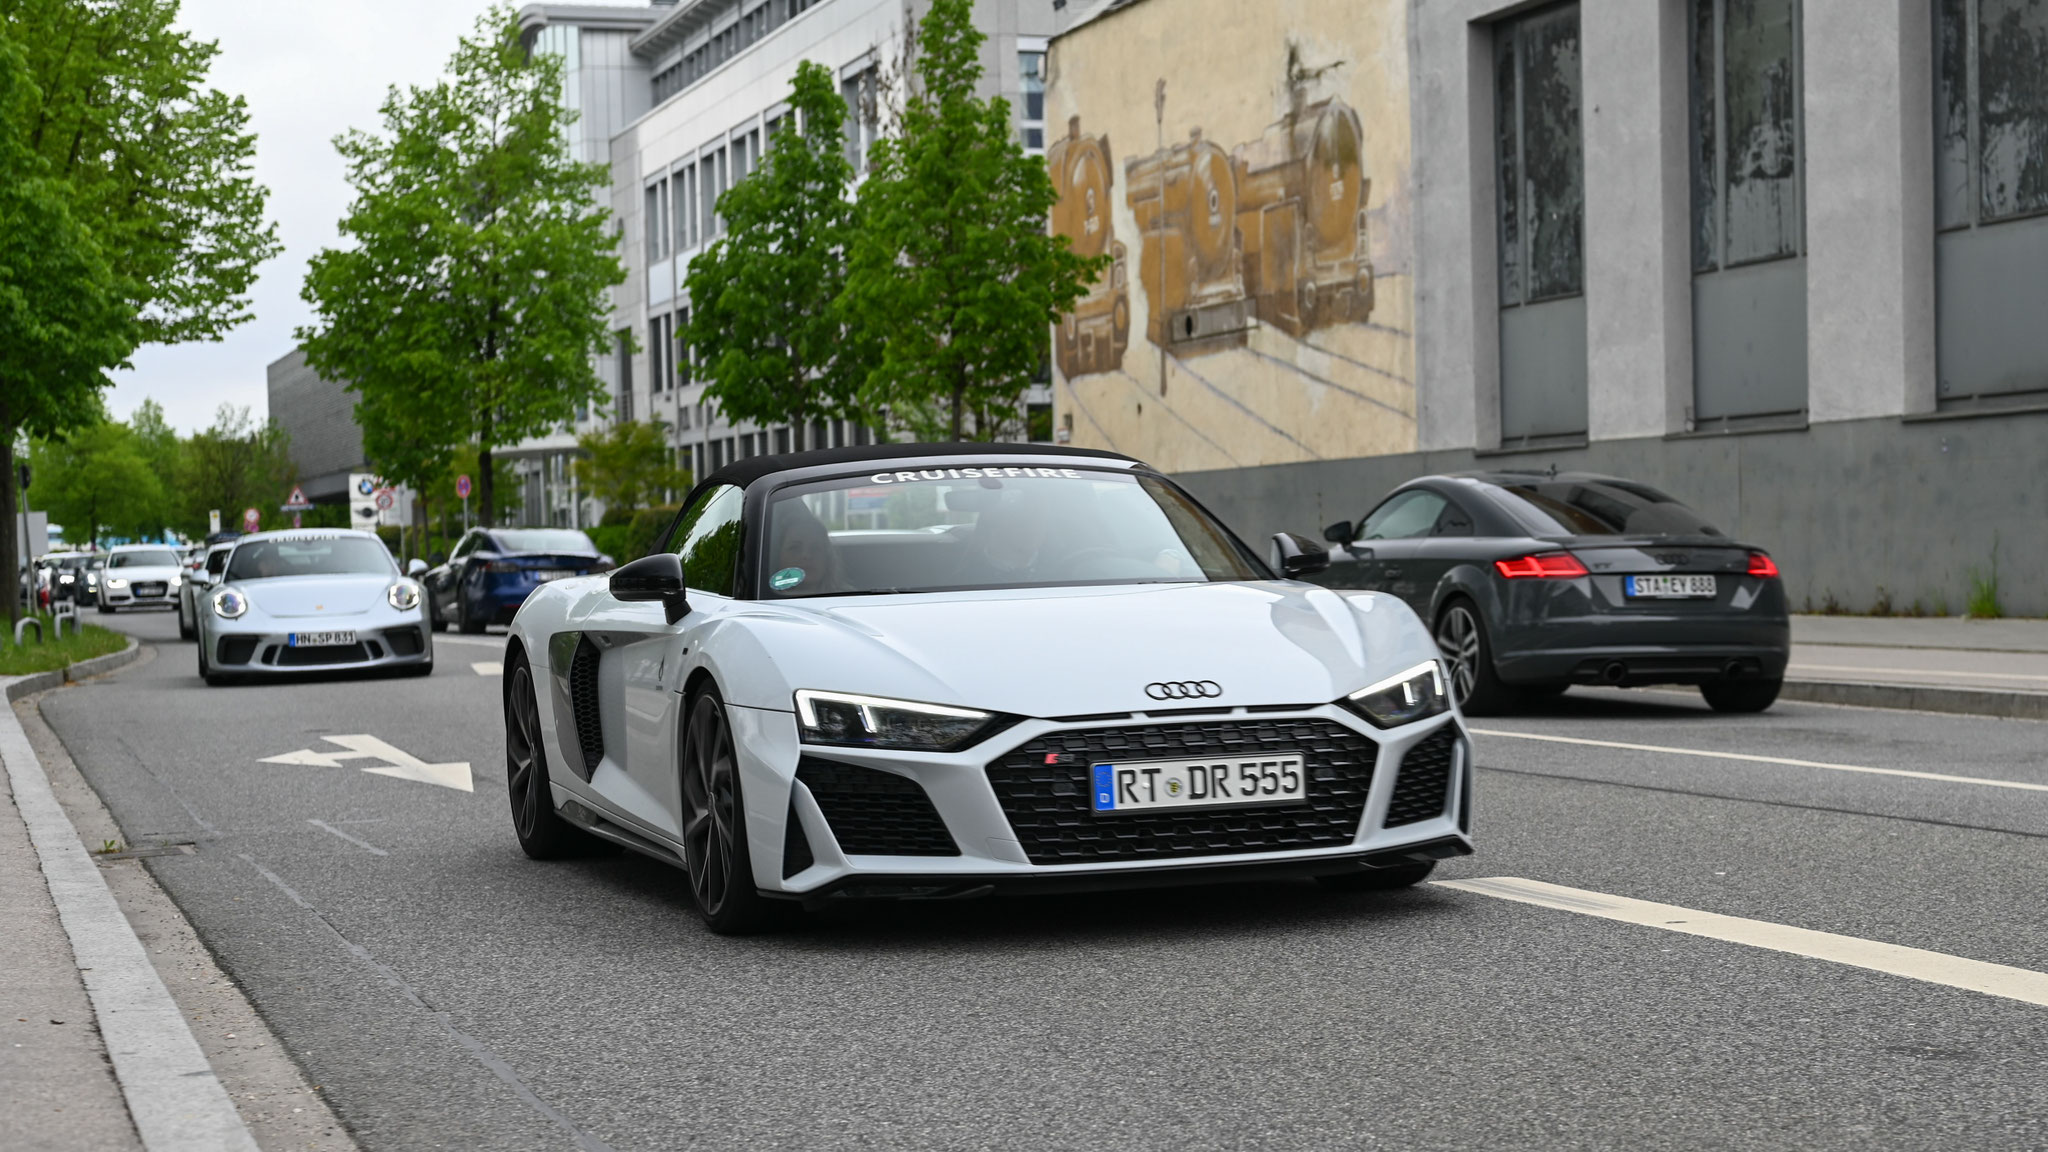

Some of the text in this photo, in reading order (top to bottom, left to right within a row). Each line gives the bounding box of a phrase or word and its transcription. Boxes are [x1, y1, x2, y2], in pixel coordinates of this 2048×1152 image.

[870, 467, 1083, 484] CRUISEFIRE
[1635, 576, 1714, 593] STA EY 888
[296, 633, 311, 645] HN
[318, 632, 333, 644] SP
[1117, 767, 1162, 804] RT
[1187, 764, 1232, 800] DR
[1238, 760, 1299, 797] 555
